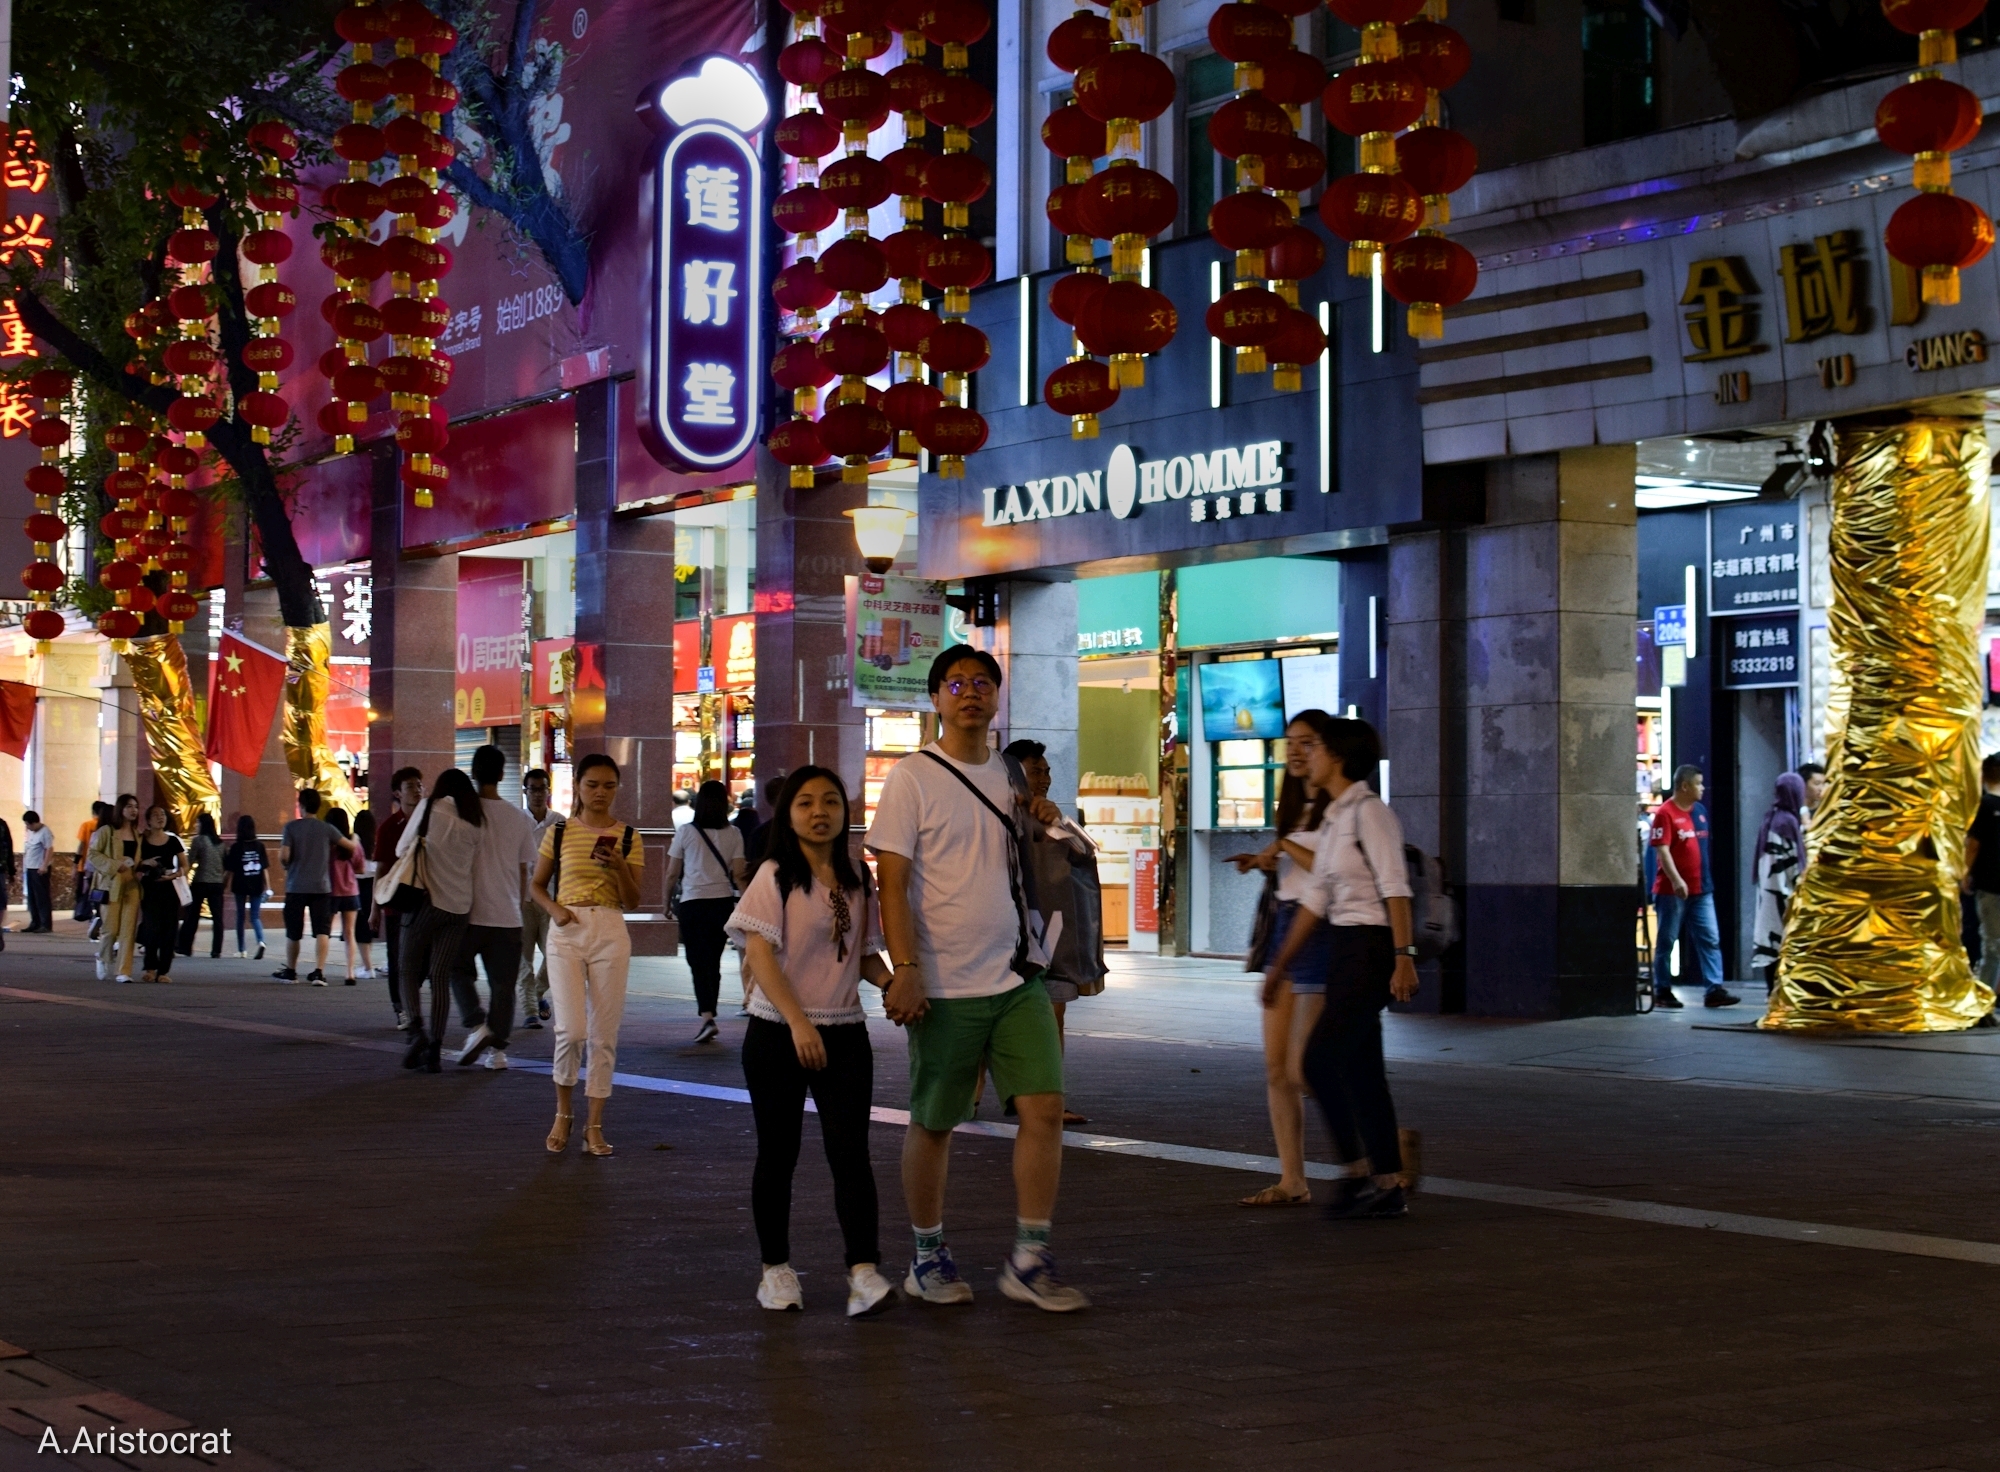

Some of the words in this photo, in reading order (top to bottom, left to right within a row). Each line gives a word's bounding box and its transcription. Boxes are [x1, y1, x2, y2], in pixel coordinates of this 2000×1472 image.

[1349, 81, 1415, 104] 盛大开业
[683, 165, 739, 426] 莲籽堂
[496, 284, 563, 335] 始创1889
[1716, 371, 1749, 404] JIN
[1816, 354, 1855, 387] YU
[1905, 331, 1987, 372] GUANG
[981, 470, 1102, 527] LAXDN
[1138, 440, 1284, 504] HOMME
[1739, 522, 1796, 545] 广州市
[909, 634, 922, 646] 70
[1735, 627, 1790, 648] 财富热线
[1730, 655, 1795, 674] 83332818
